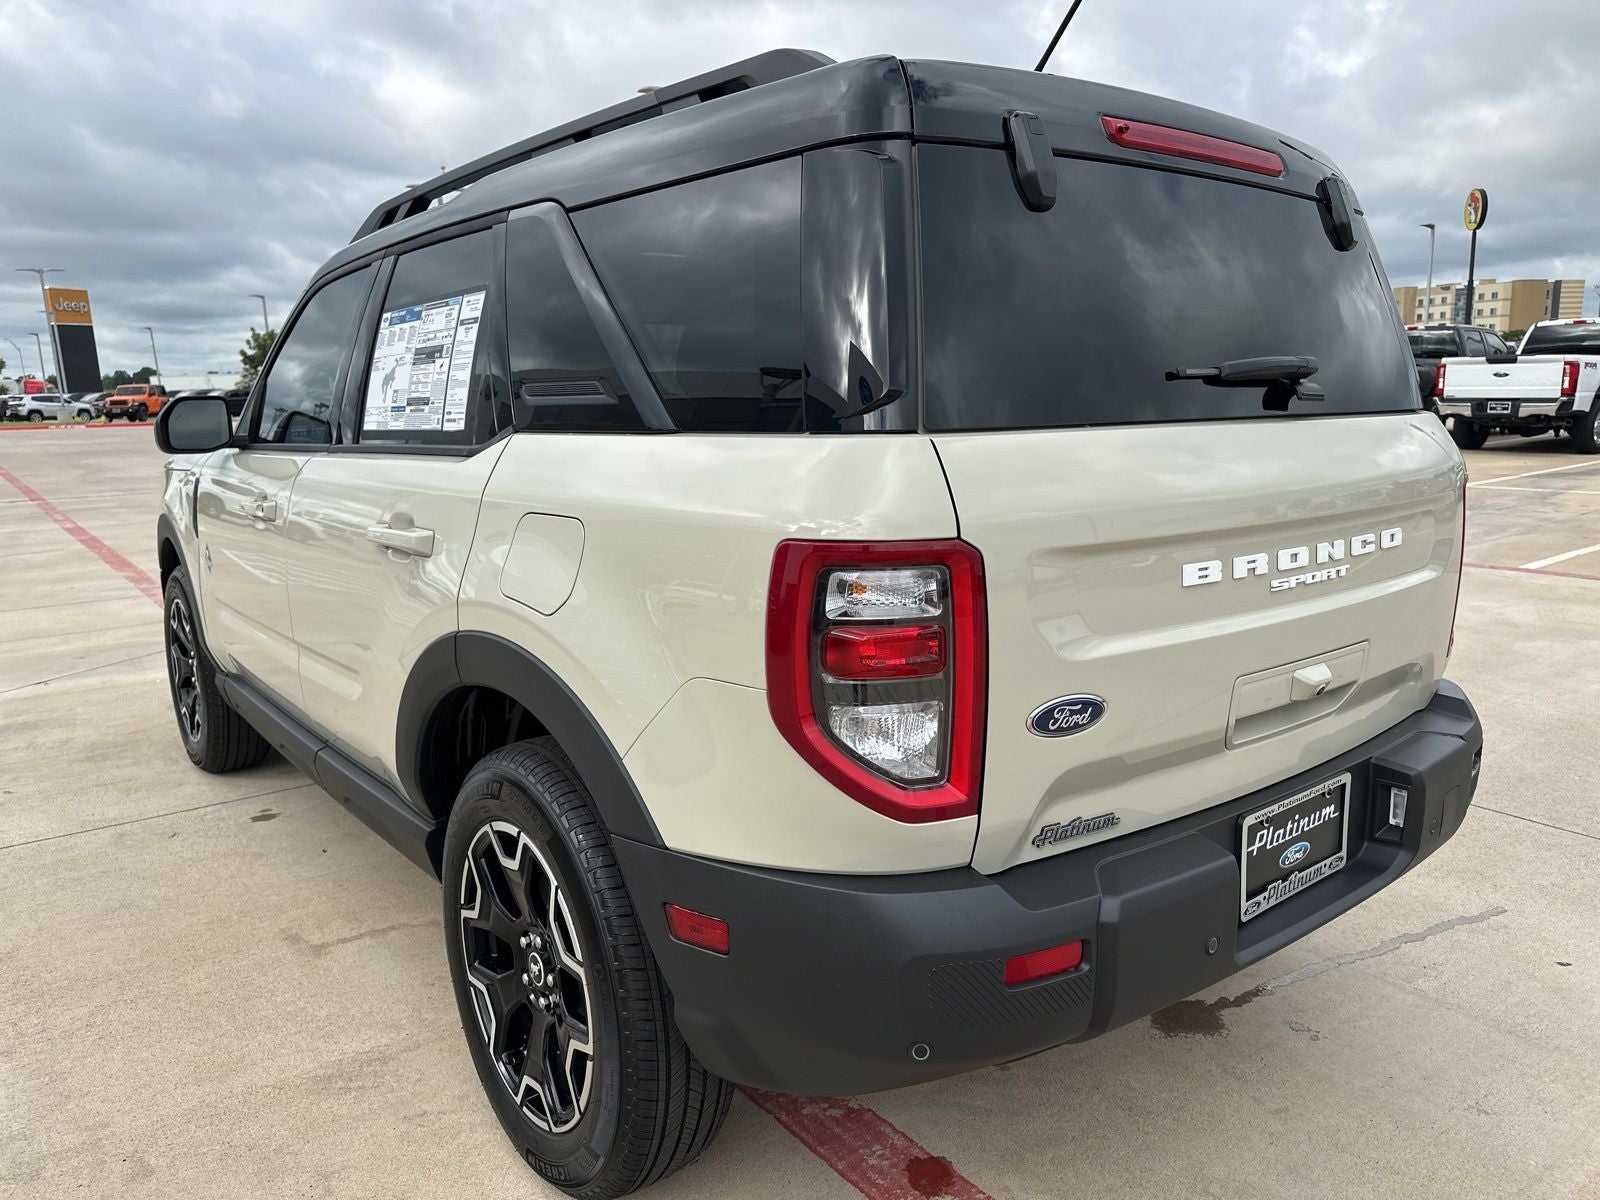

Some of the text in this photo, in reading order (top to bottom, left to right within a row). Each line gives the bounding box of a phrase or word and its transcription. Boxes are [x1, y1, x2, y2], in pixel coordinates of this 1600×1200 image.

[55, 297, 88, 315] Jeep
[1182, 527, 1403, 587] BRONCO
[1270, 564, 1351, 592] SPORT
[1049, 704, 1091, 730] Ford
[1254, 778, 1342, 821] www.PlatinumFord.com
[1032, 812, 1121, 848] Platinum
[1247, 803, 1339, 856] Platinum
[1267, 866, 1326, 904] Platinum
